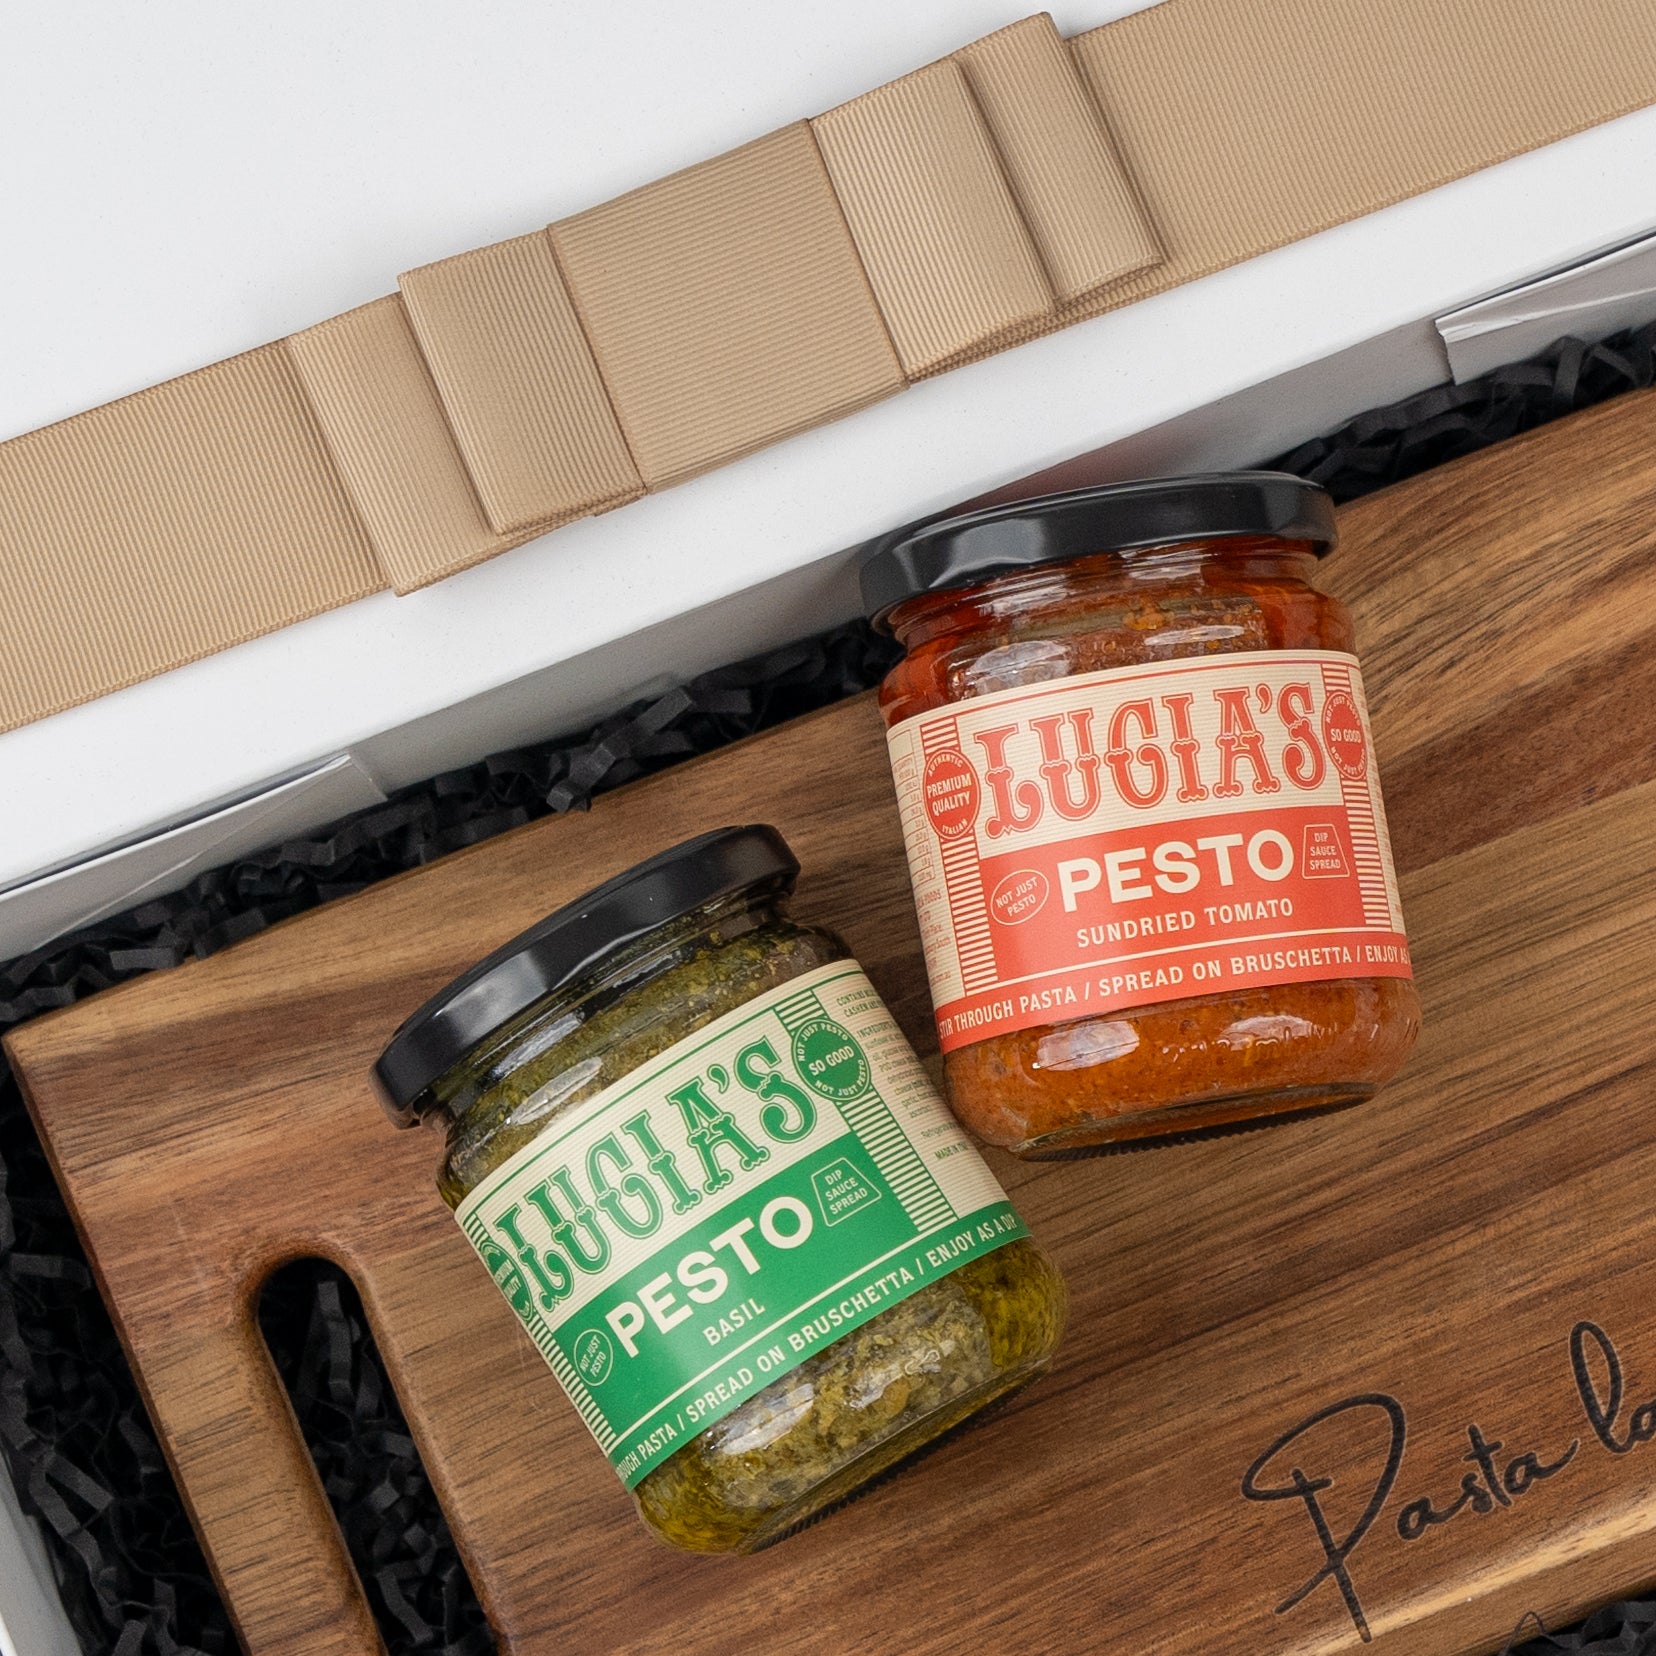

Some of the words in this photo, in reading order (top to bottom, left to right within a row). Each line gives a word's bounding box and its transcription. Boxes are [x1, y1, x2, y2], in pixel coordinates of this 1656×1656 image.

[1330, 728, 1342, 742] SO
[1343, 728, 1361, 744] GOOD
[928, 753, 964, 777] AUTHENTIC
[926, 772, 972, 799] PREMIUM
[932, 790, 970, 817] QUALITY
[942, 818, 968, 835] ITALIAN
[1314, 832, 1329, 843] DIP
[1309, 858, 1341, 871] SPREAD
[1310, 845, 1337, 857] SAUCE
[1057, 829, 1295, 913] PESTO
[995, 891, 1013, 909] NOT
[1015, 876, 1038, 897] JUST
[1007, 893, 1036, 917] PESTO
[1076, 910, 1196, 948] SUNDRIED
[1204, 898, 1294, 926] TOMATO
[954, 999, 1014, 1033] THROUGH
[1019, 985, 1077, 1014] PASTA
[1099, 966, 1184, 997] SPREAD
[1192, 960, 1222, 980] ON
[1230, 946, 1352, 975] BRUSCHETTA
[1365, 945, 1398, 963] ENJOY
[801, 1023, 818, 1042] JUST
[820, 1023, 848, 1041] PESTO
[797, 1042, 806, 1062] NOT
[808, 1060, 826, 1076] SO
[825, 1045, 855, 1067] GOOD
[815, 1080, 835, 1094] NOT
[838, 1084, 858, 1096] JUST
[857, 1059, 866, 1087] PESTO
[824, 1169, 844, 1186] DIP
[824, 1177, 859, 1201] SAUCE
[829, 1187, 868, 1216] SPREAD
[604, 1196, 814, 1359] PESTO
[702, 1298, 767, 1346] BASIL
[586, 1334, 601, 1358] JUST
[636, 1422, 678, 1461] PASTA
[685, 1367, 754, 1424] SPREAD
[756, 1345, 786, 1373] ON
[787, 1267, 915, 1353] BRUSCHETTA
[925, 1231, 977, 1269] ENJOY
[978, 1221, 996, 1242] AS
[995, 1218, 1005, 1234] A
[1004, 1213, 1018, 1231] DIP
[590, 1351, 607, 1378] PESTO
[1242, 1392, 1582, 1644] Pasta
